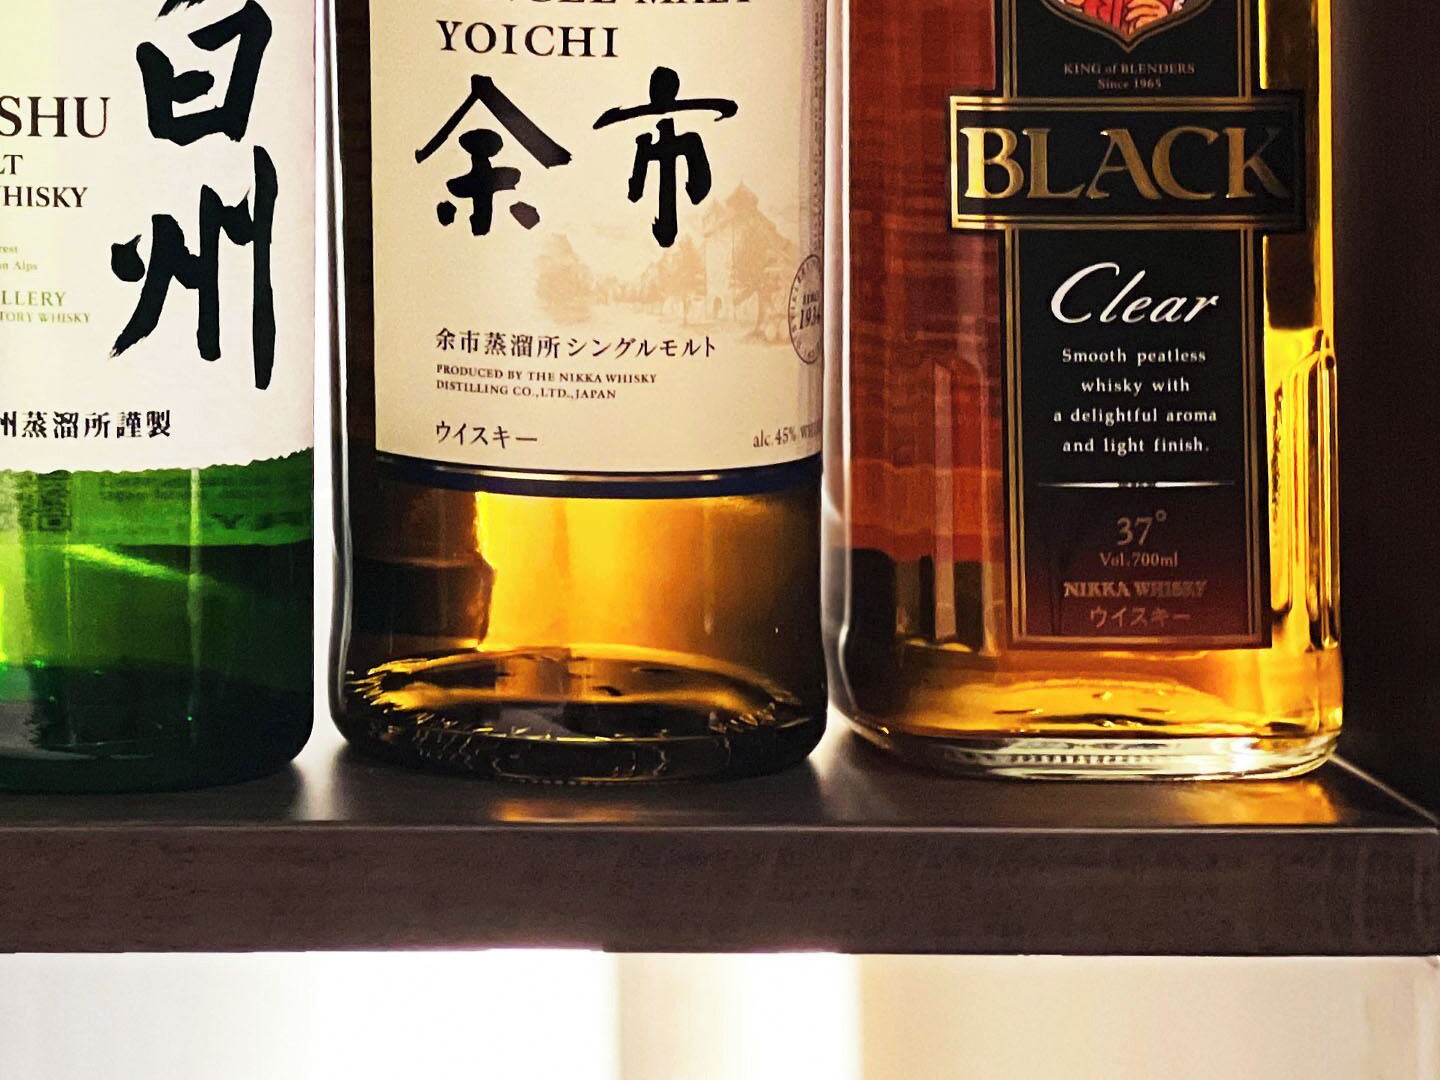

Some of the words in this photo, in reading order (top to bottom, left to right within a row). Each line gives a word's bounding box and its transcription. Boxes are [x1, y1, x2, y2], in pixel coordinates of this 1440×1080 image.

[436, 19, 619, 58] YOICHI
[1064, 63, 1101, 75] KING
[1105, 63, 1117, 74] of
[1120, 63, 1196, 74] BLENDERS
[1098, 78, 1130, 89] Since
[1135, 78, 1161, 89] 1965
[415, 66, 739, 248] 余市
[960, 126, 1290, 200] BLACK
[15, 260, 38, 272] Alps
[1050, 261, 1219, 324] Clear
[38, 312, 90, 324] WHISKY
[1062, 348, 1127, 363] Smooth
[1137, 348, 1206, 365] peatless
[436, 364, 503, 379] PRODUCED
[507, 369, 523, 380] BY
[527, 371, 555, 381] THE
[559, 372, 602, 383] NIKKA
[606, 373, 657, 384] WHISKY
[436, 380, 508, 395] DISTILLING
[1081, 377, 1142, 397] whisky
[1152, 378, 1189, 393] with
[1054, 411, 1062, 422] a
[1070, 408, 1157, 427] delightful
[1166, 410, 1217, 422] aroma
[435, 420, 538, 449] ウイスキー
[1062, 438, 1094, 452] and
[1103, 438, 1144, 456] light
[1154, 437, 1209, 453] finish.
[1063, 581, 1131, 598] NIKKA
[1134, 580, 1209, 597] WHISKY
[1090, 606, 1192, 628] ウイスキー
